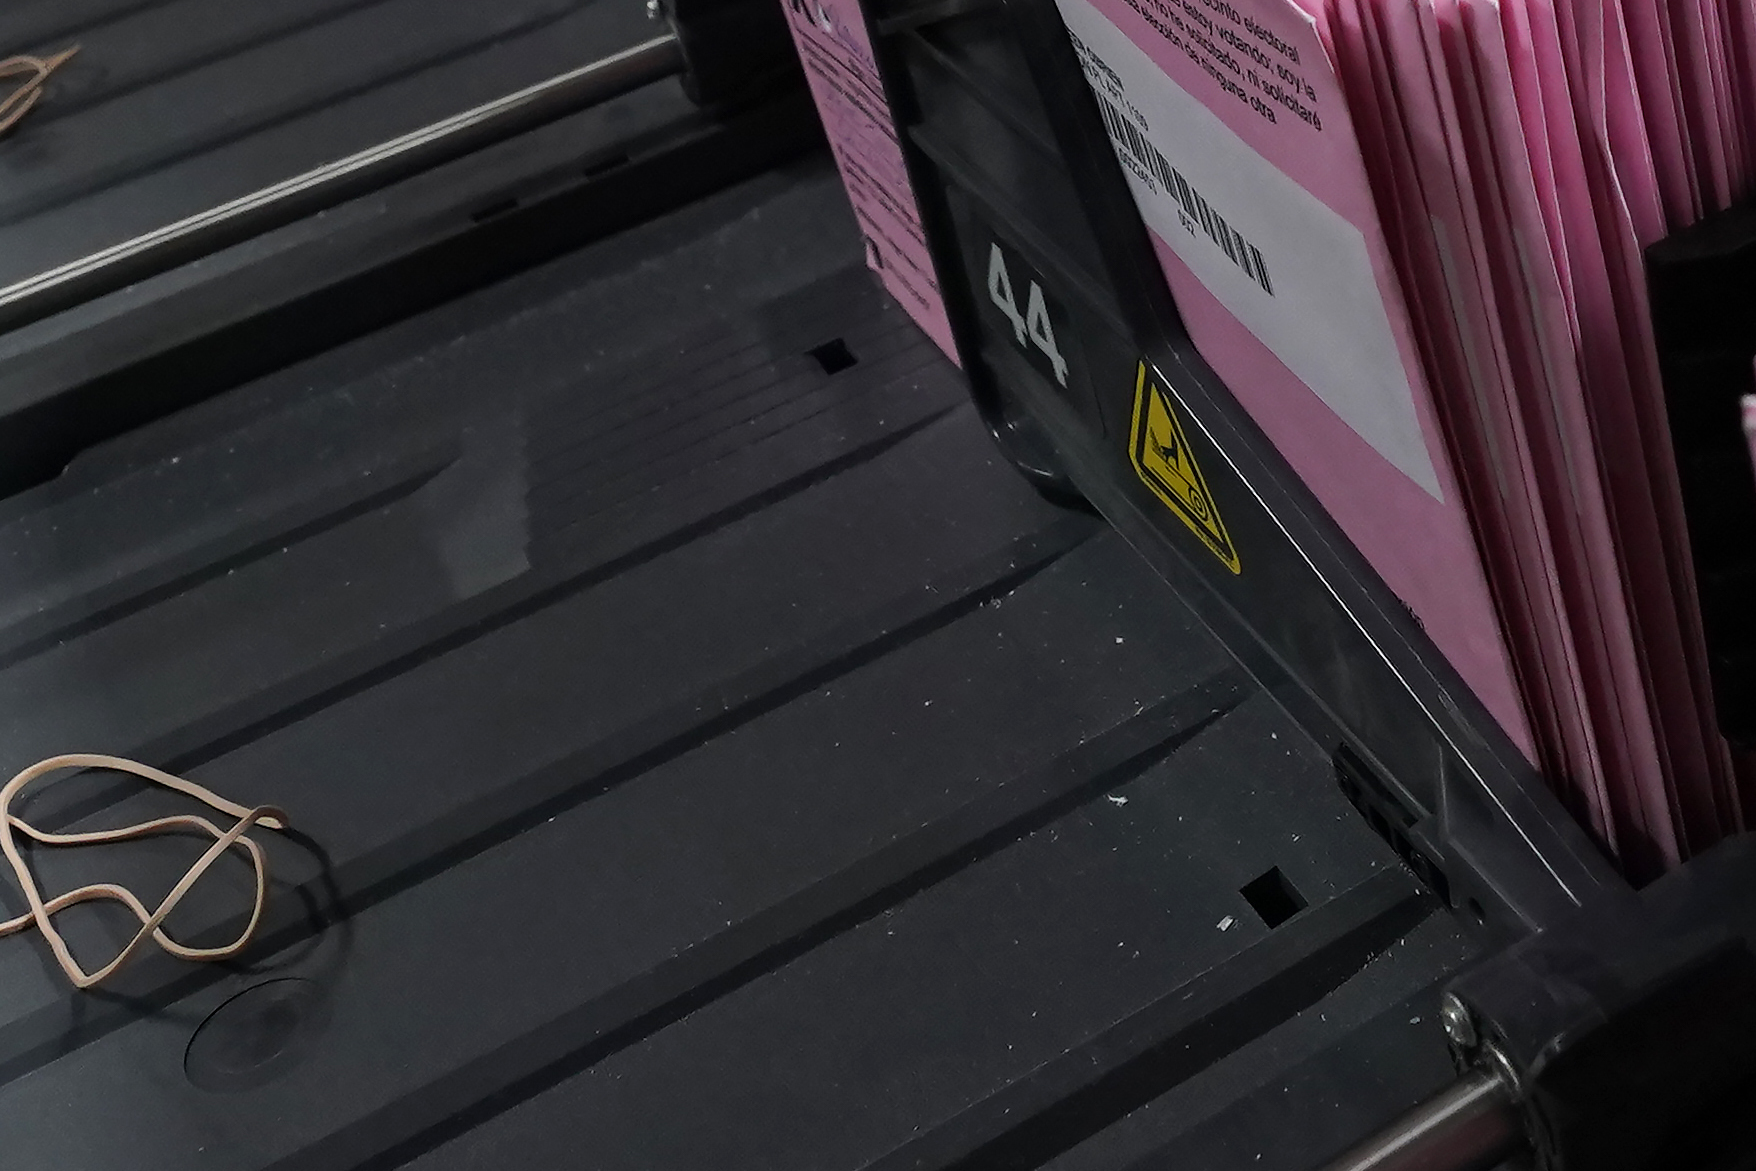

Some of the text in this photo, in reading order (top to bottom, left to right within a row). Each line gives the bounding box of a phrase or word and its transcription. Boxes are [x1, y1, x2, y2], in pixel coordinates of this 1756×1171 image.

[1244, 16, 1301, 65] electoral
[1247, 67, 1261, 92] ni
[1261, 79, 1322, 132] solicitaré
[1276, 63, 1300, 94] soy
[1302, 77, 1317, 103] la
[1250, 96, 1278, 125] otra
[987, 241, 1069, 390] 44
